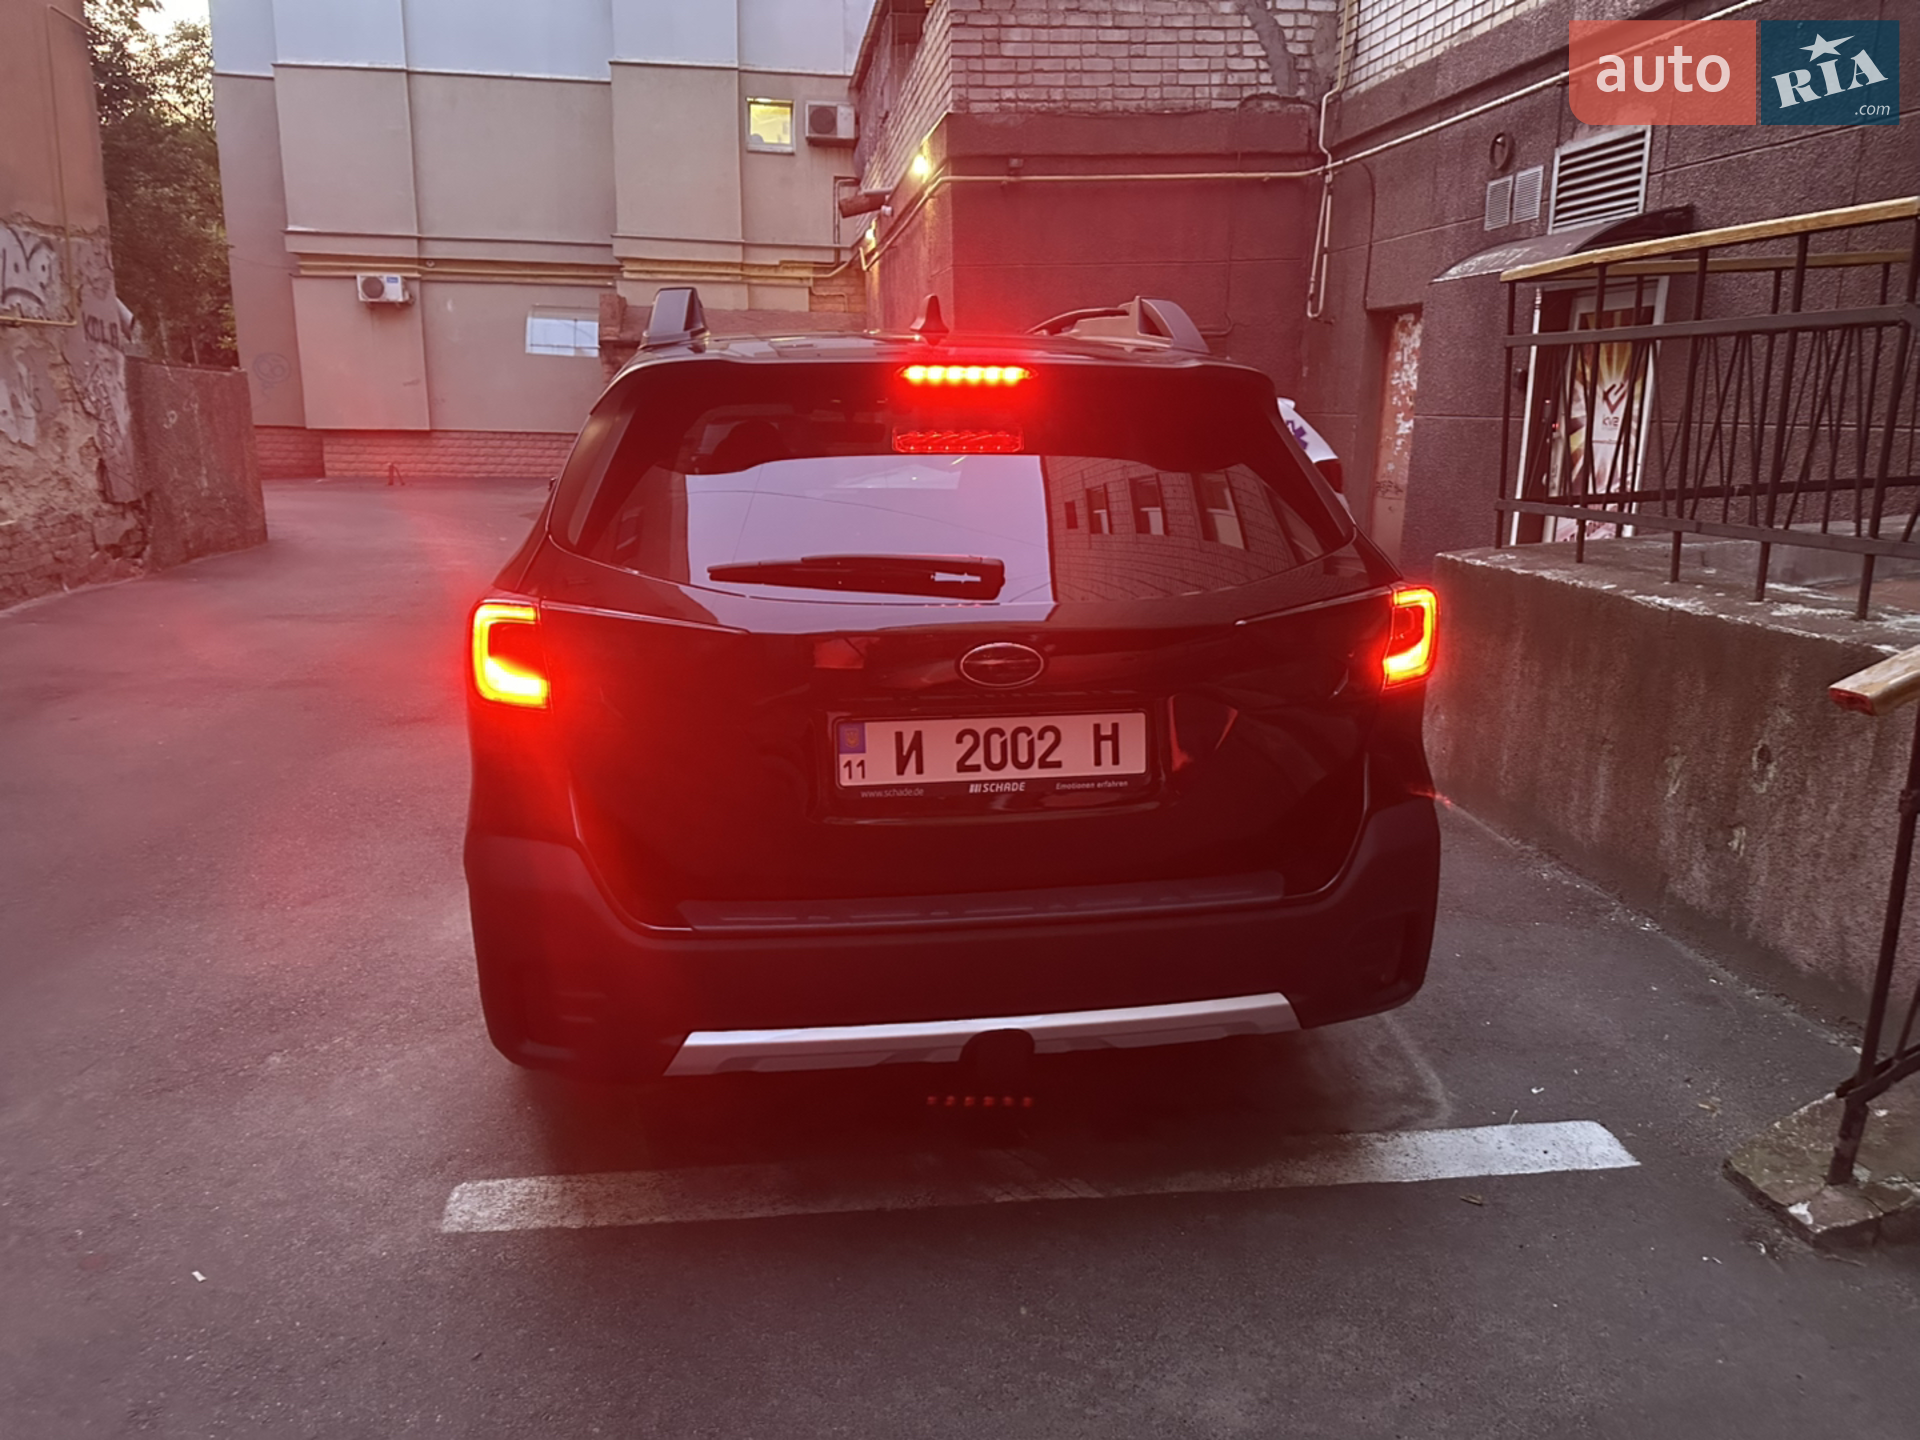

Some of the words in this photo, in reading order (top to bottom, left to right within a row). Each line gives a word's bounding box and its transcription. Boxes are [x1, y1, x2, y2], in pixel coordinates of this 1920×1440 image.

[955, 725, 1063, 773] 2002
[843, 759, 866, 780] 11
[982, 781, 1027, 793] SCHADE
[1055, 782, 1096, 790] Emotionen
[1096, 780, 1129, 788] erfahren
[860, 787, 925, 798] www.schade.de
